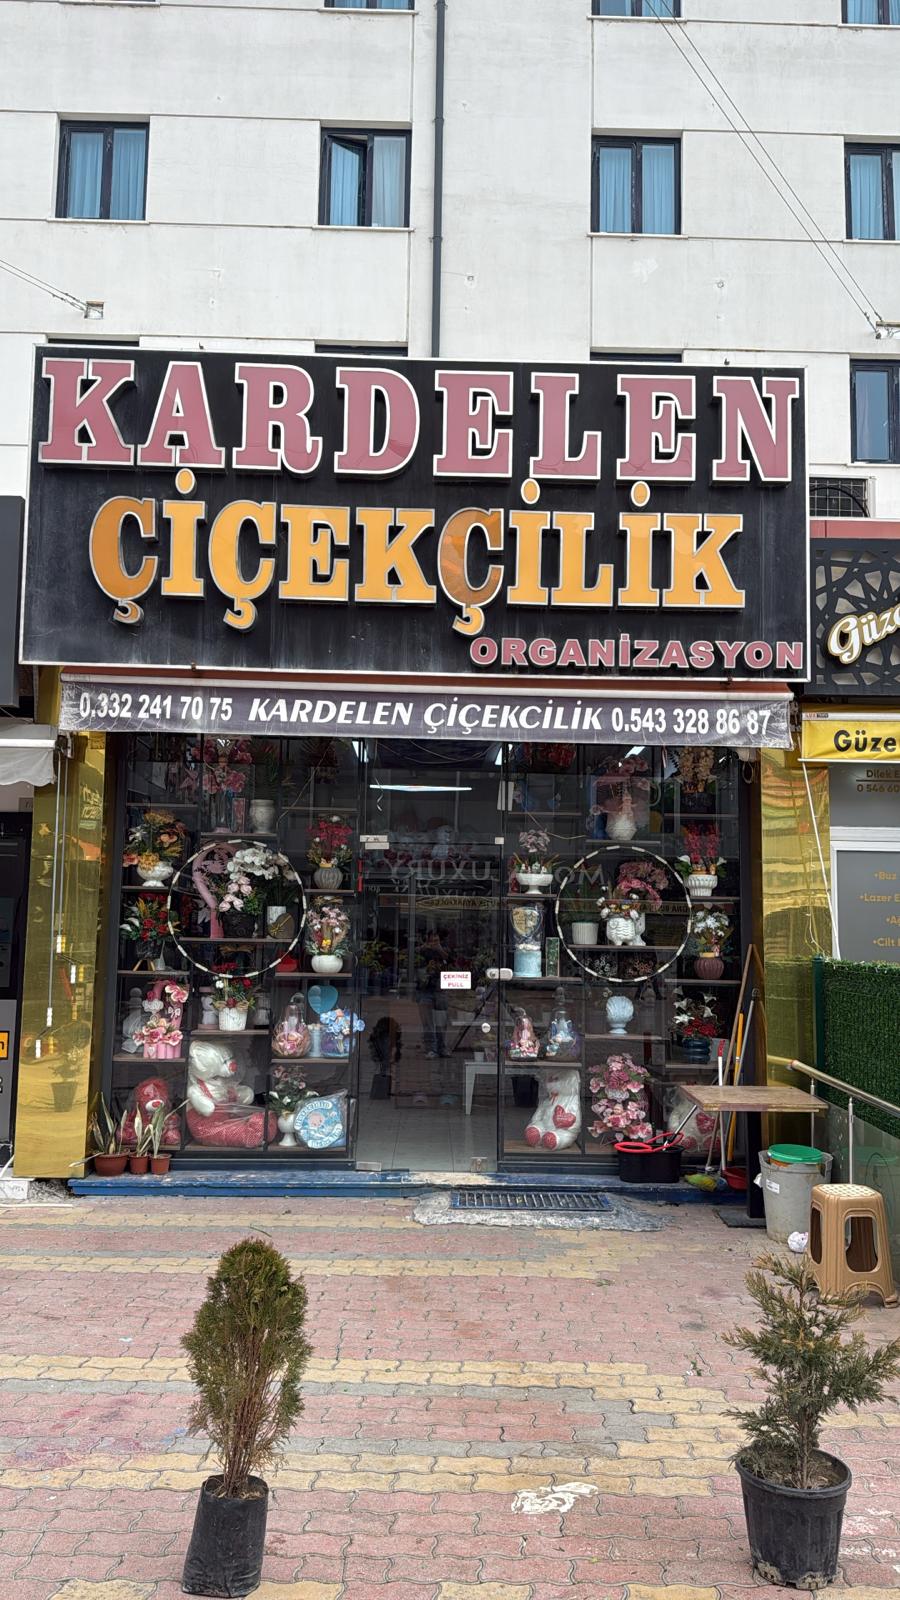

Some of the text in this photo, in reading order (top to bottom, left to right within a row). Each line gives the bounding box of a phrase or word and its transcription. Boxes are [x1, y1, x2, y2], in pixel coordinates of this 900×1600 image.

[38, 357, 800, 483] KARDELEN
[88, 468, 746, 636] ÇİÇEKÇİLİK
[470, 633, 804, 670] ORGANİZASYON
[79, 692, 772, 735] 0.332 241 70 75 KARDELEN ÇİÇEKCİLİK 0.543 328 86 87
